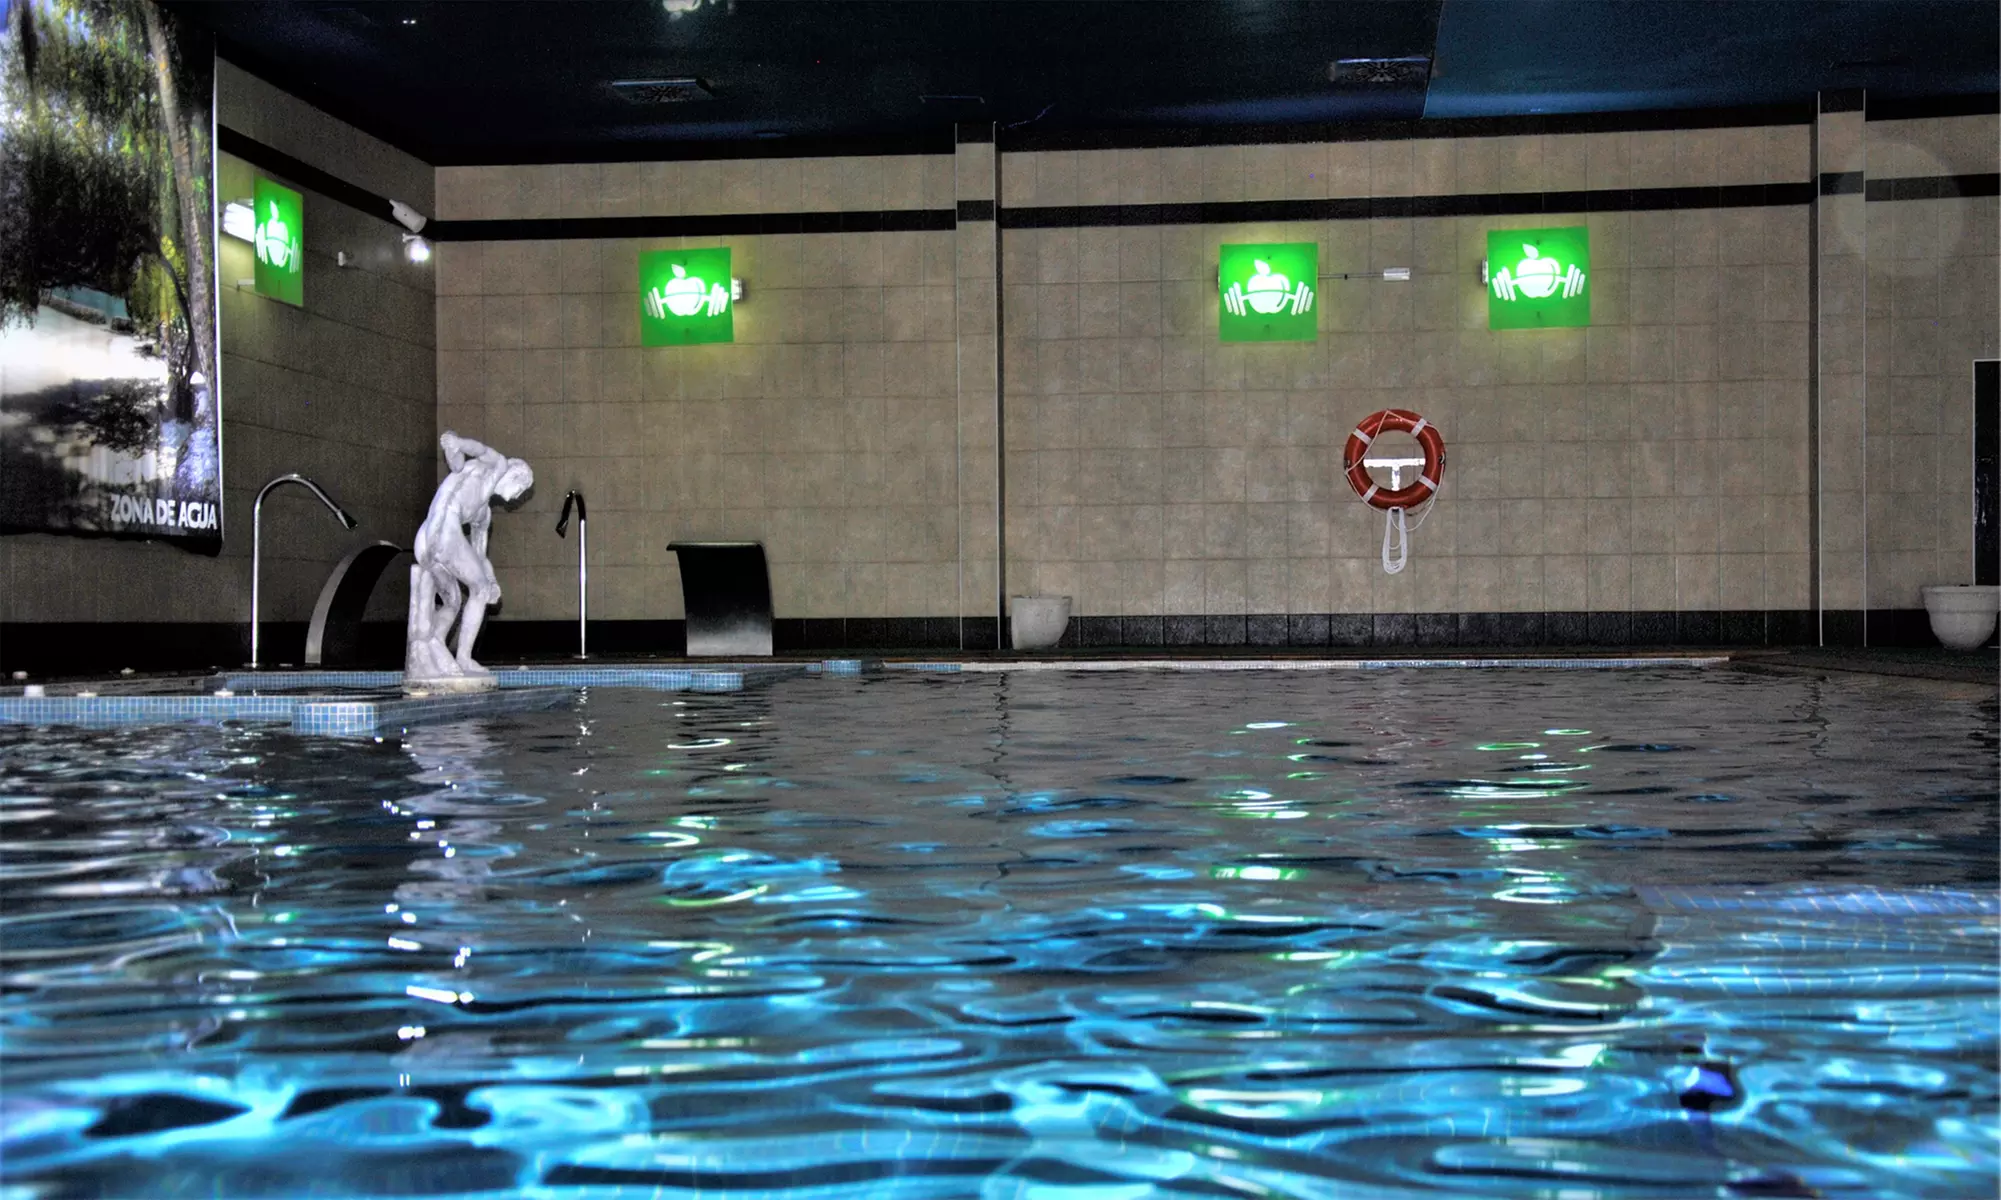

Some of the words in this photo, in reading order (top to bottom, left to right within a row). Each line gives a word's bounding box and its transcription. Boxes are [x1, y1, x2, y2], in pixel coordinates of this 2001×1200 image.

[110, 494, 154, 524] ZONA
[156, 499, 176, 526] DE
[178, 501, 217, 530] AGUA
